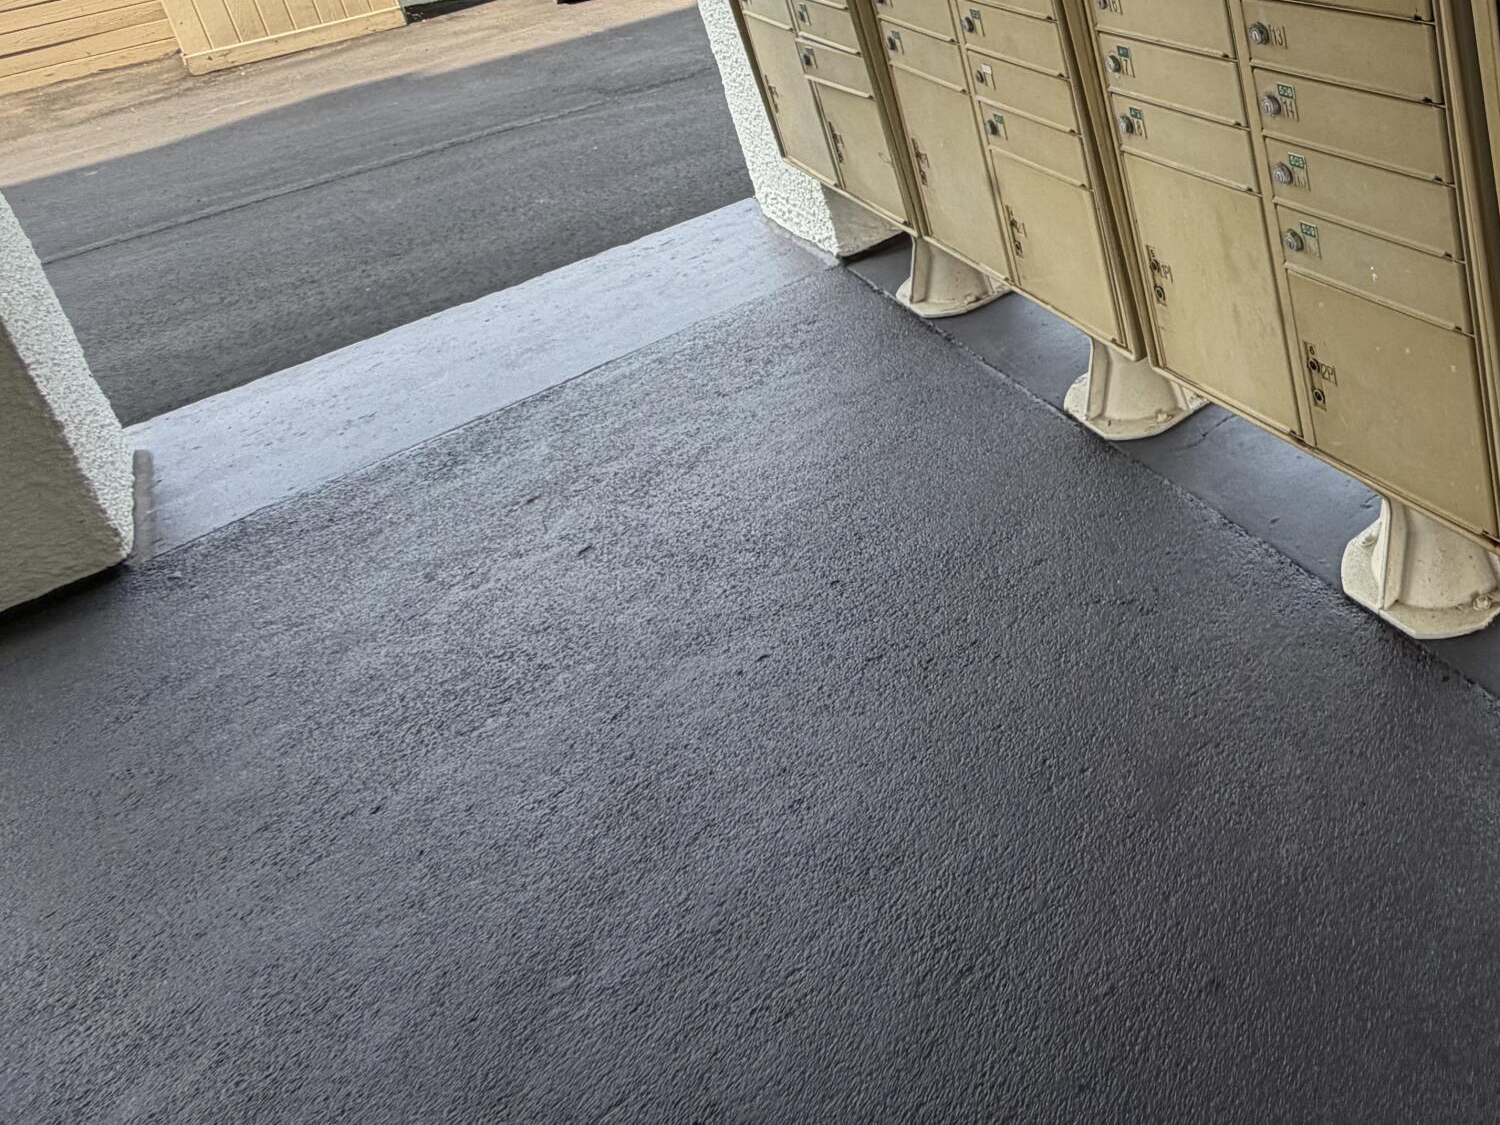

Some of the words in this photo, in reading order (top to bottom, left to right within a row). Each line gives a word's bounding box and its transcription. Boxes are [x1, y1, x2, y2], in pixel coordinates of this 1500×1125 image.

[1271, 26, 1284, 47] 13
[1121, 58, 1129, 75] 7
[1282, 98, 1295, 120] 14
[1321, 363, 1334, 382] 2P
